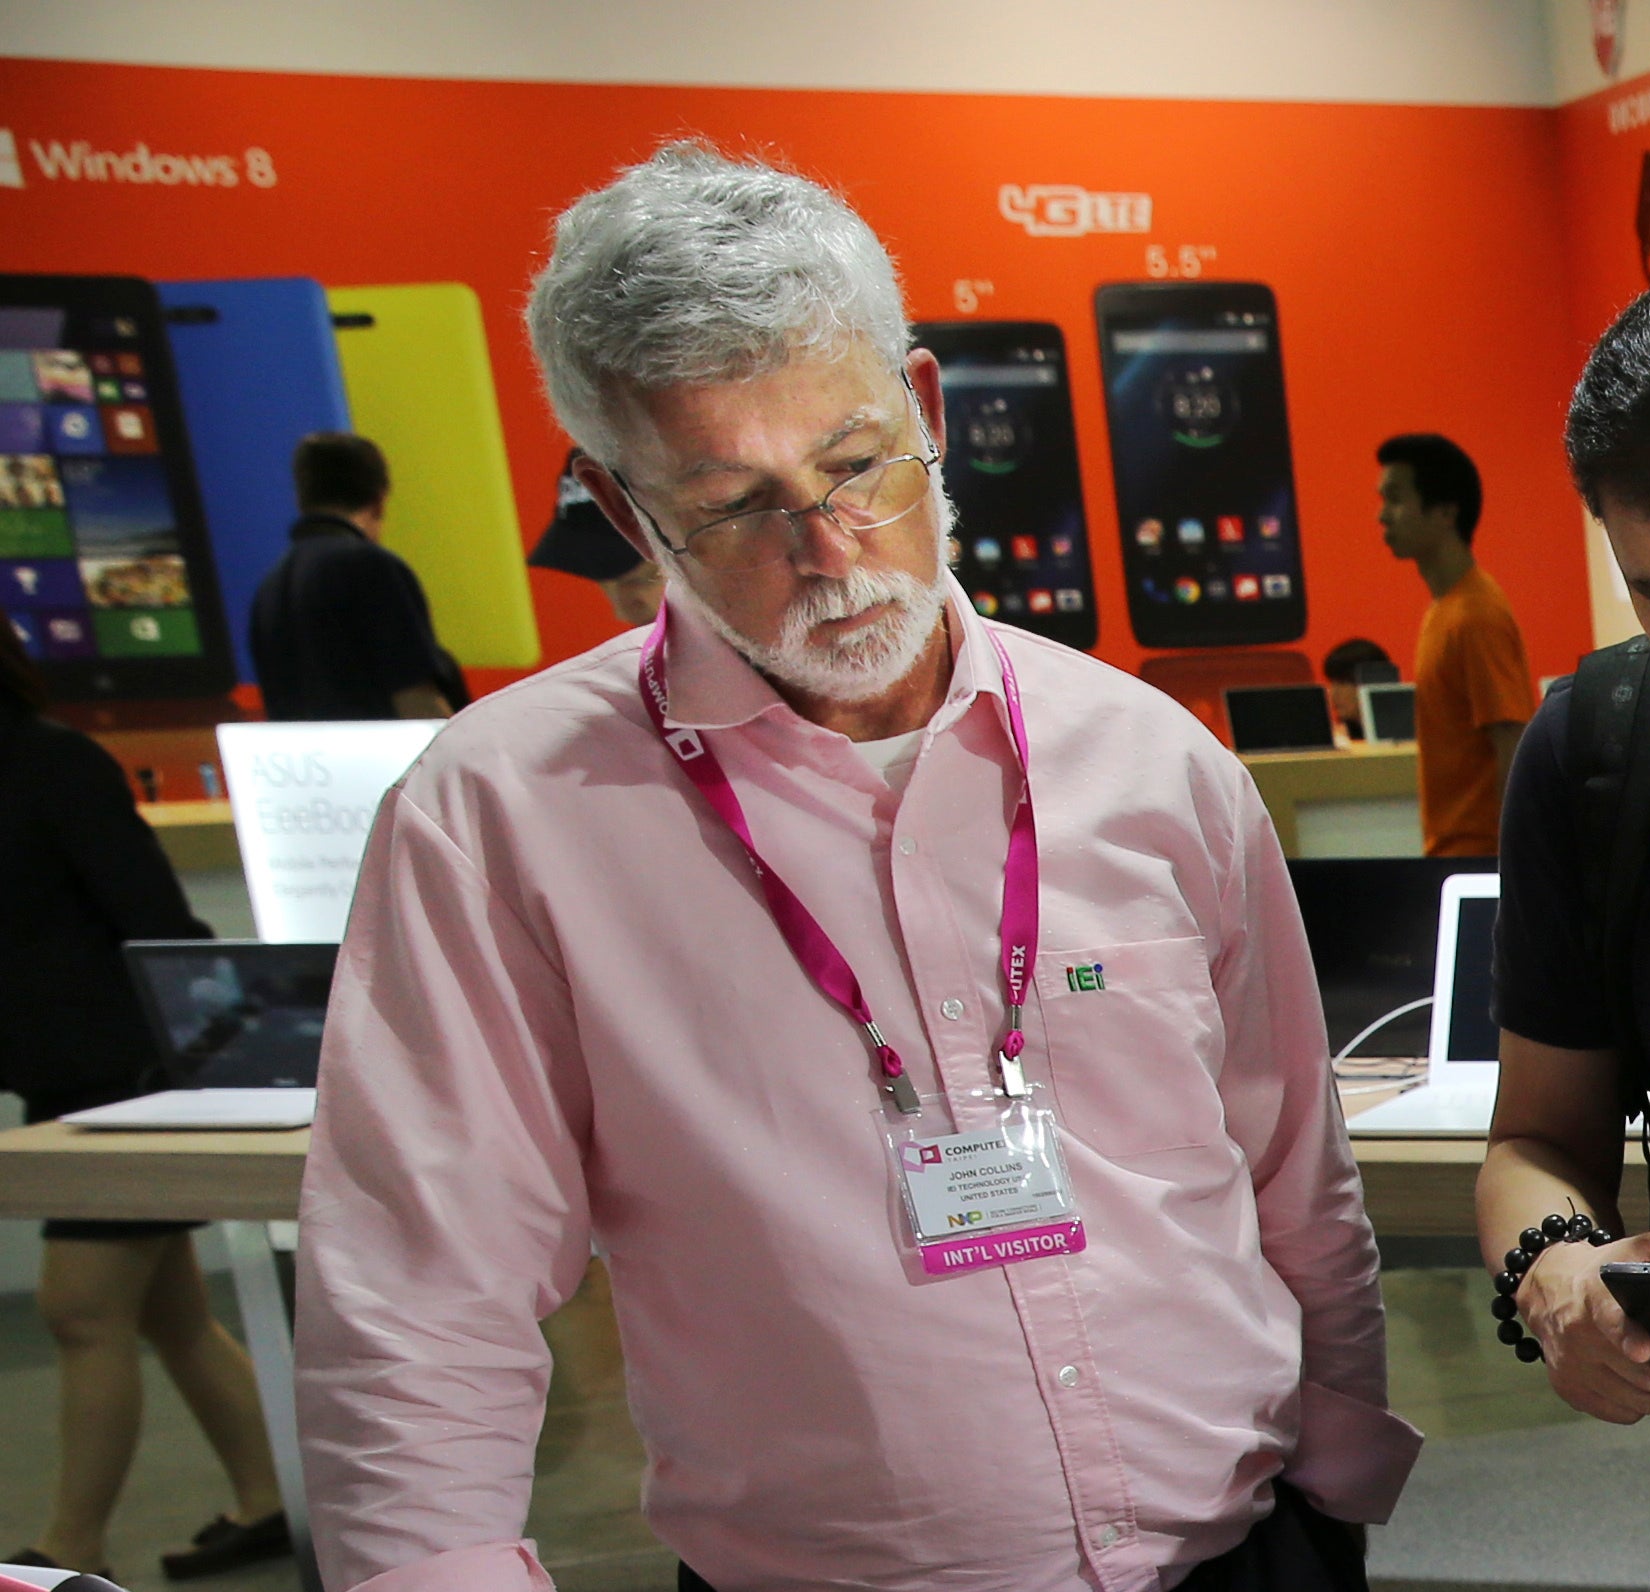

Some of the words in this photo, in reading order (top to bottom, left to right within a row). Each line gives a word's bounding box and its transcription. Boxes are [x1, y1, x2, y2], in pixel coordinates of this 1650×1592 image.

[29, 139, 240, 188] Windows
[245, 146, 278, 189] 8
[253, 752, 333, 787] ASUS
[256, 797, 376, 833] EeeBoo
[949, 1169, 978, 1181] JOHN
[980, 1162, 1023, 1177] COLLINS
[958, 1177, 1011, 1193] TECHNOLOGY
[960, 1191, 989, 1203] UNITED
[990, 1187, 1019, 1199] STATES
[942, 1246, 993, 1267] INT'L
[994, 1233, 1068, 1258] VISITOR
